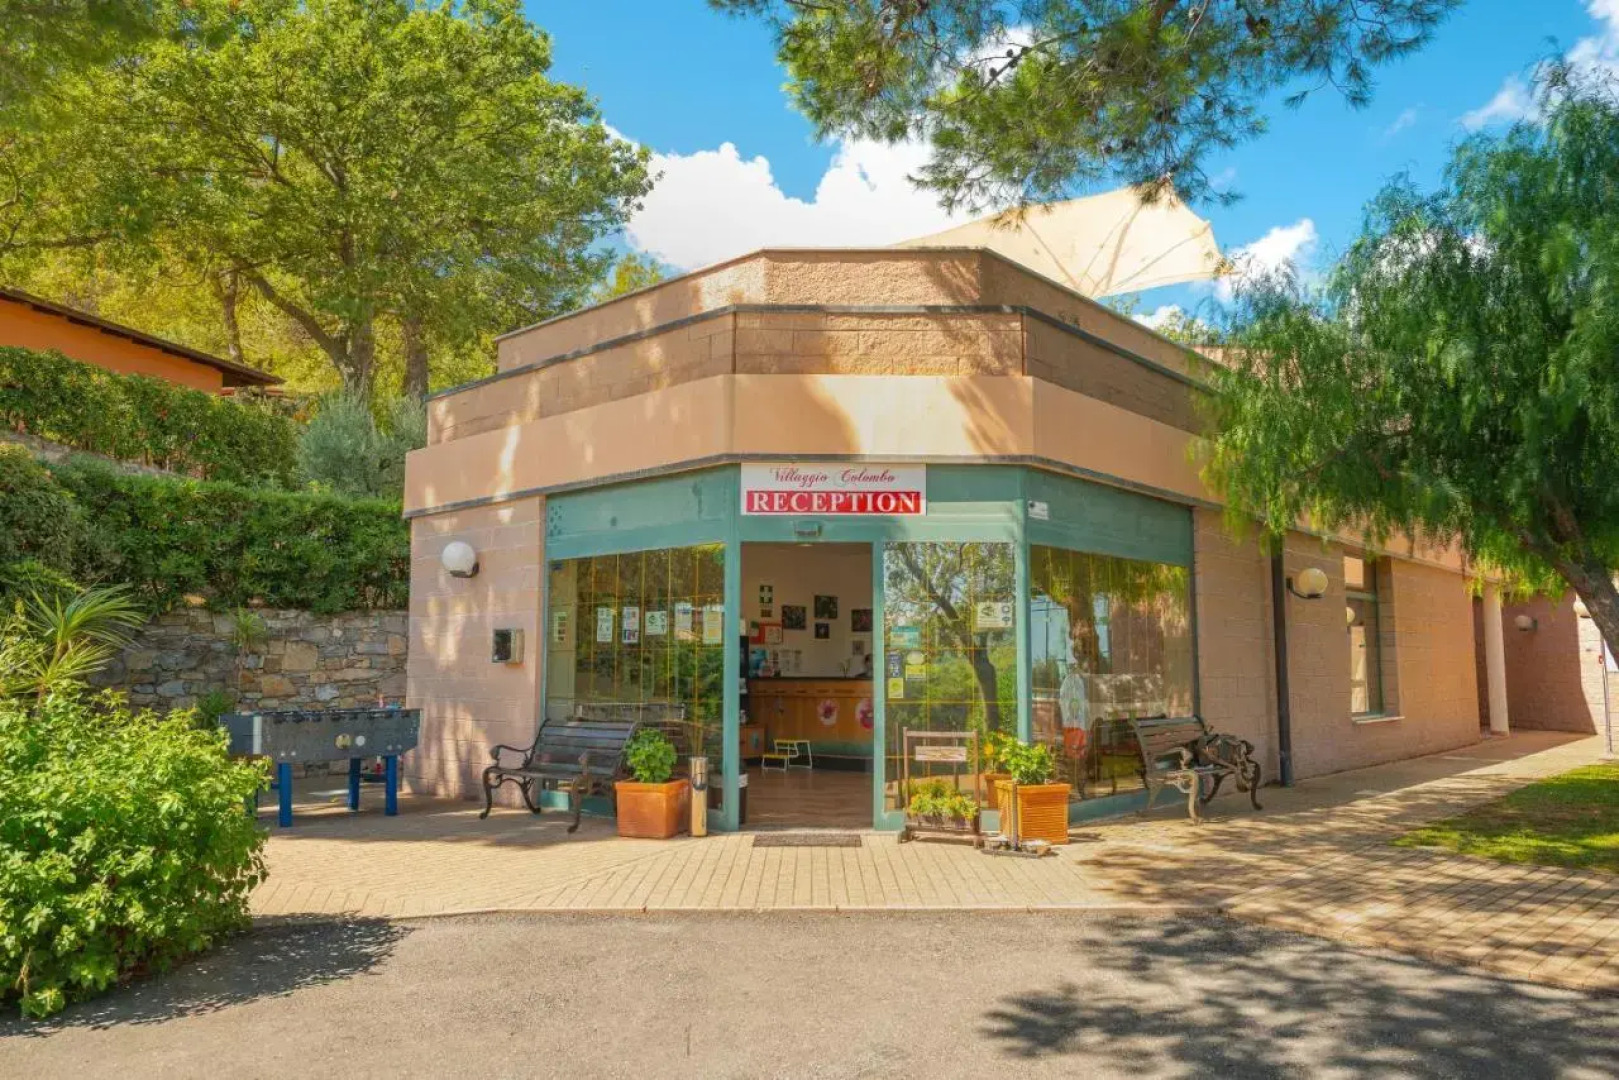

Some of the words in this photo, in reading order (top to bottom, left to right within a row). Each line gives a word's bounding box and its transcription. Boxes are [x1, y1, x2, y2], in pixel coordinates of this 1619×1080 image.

[769, 467, 830, 488] Villaggio
[835, 467, 897, 487] Colombo
[753, 492, 916, 512] RECEPTION
